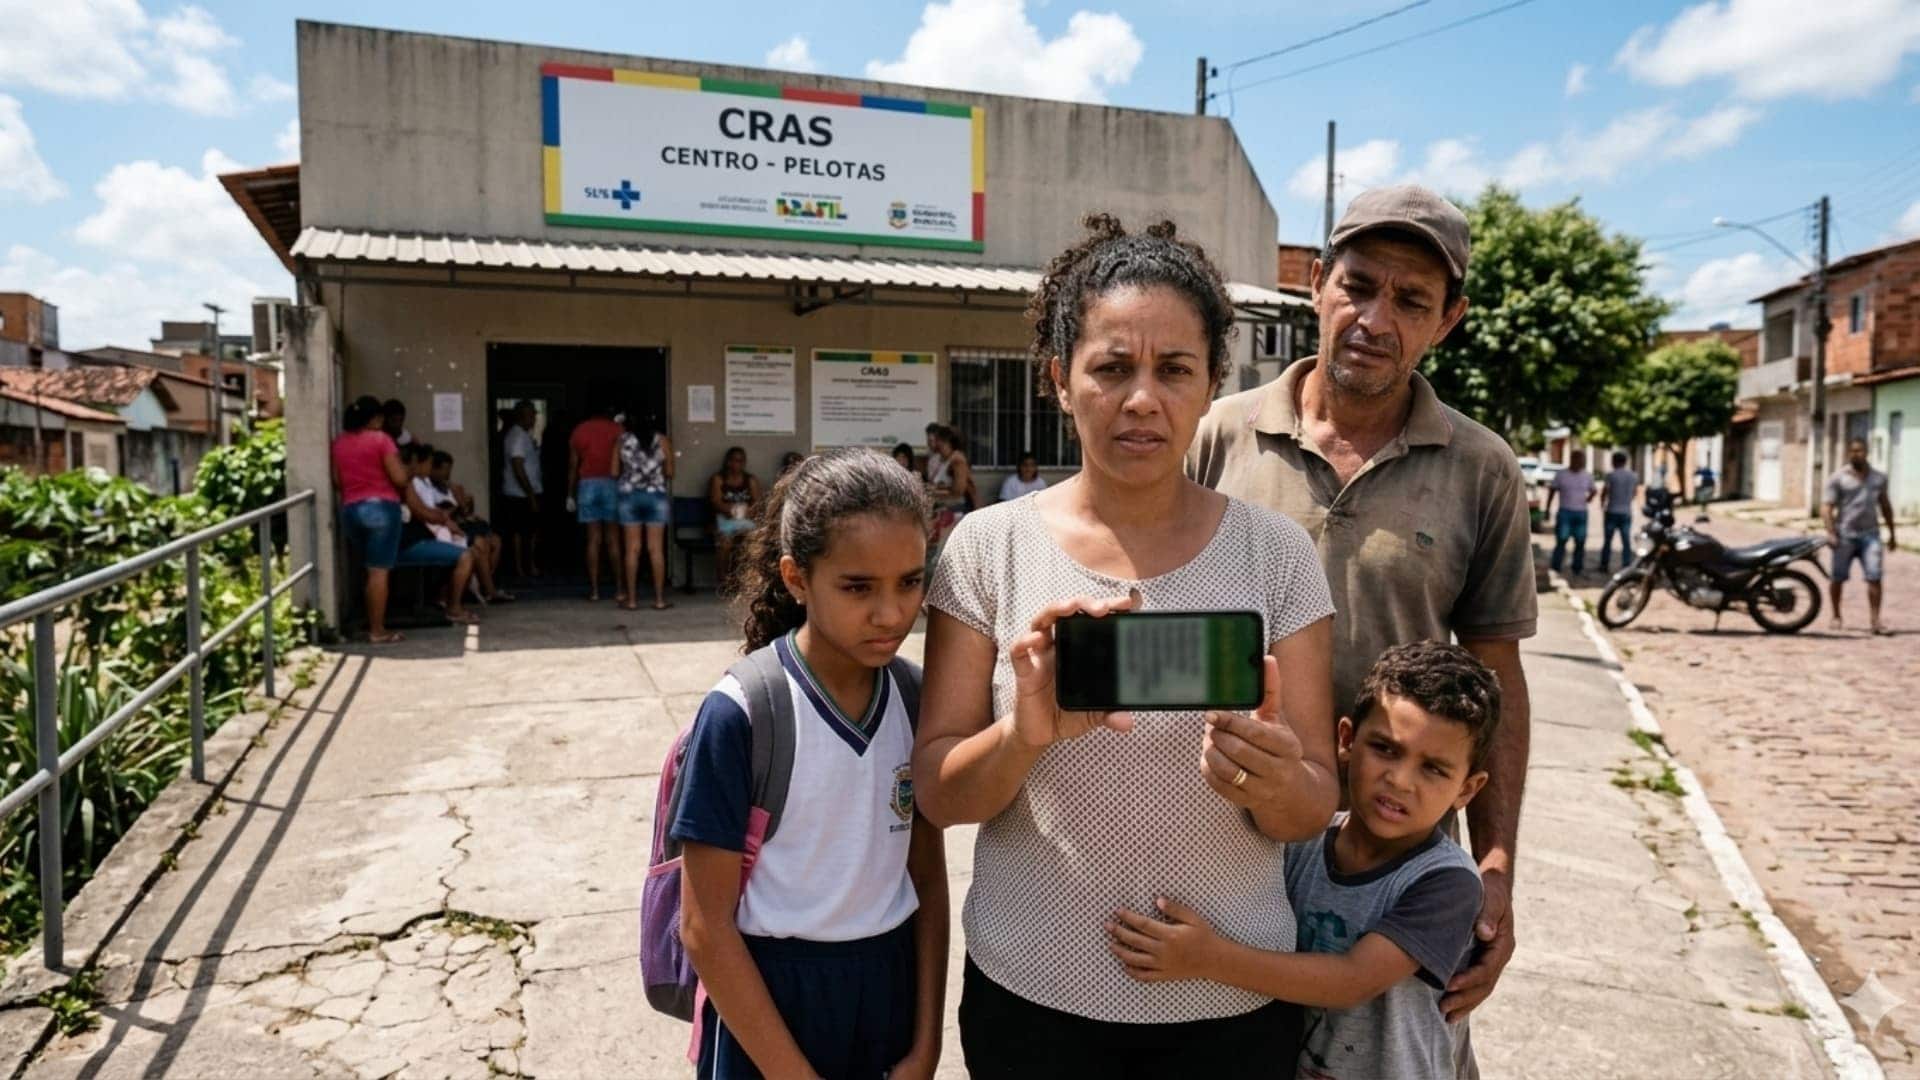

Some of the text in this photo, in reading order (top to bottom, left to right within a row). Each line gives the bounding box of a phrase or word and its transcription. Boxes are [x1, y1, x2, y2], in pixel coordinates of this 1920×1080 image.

[718, 107, 834, 147] CRAS
[661, 145, 758, 171] CENTRO
[784, 156, 886, 182] PELOTAS
